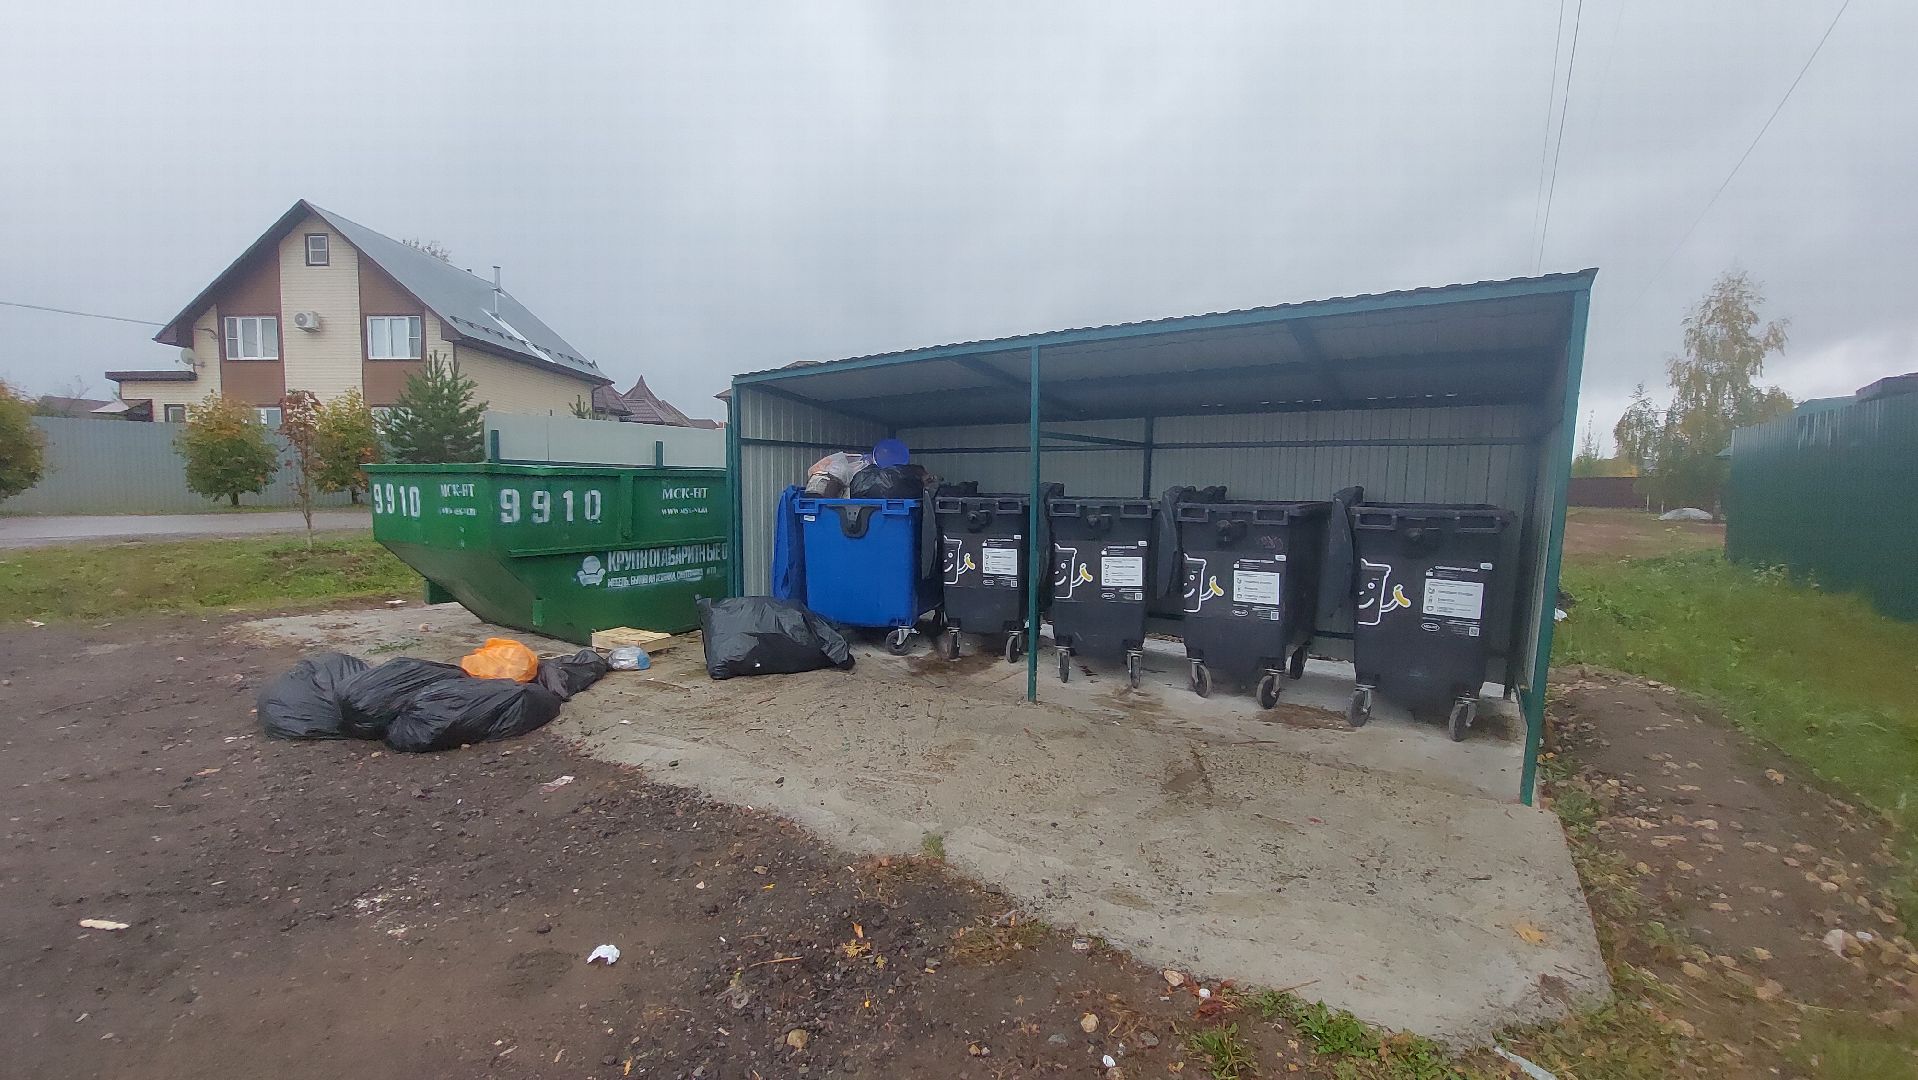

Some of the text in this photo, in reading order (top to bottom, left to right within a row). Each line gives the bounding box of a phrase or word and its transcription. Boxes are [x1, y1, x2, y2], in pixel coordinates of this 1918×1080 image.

[373, 483, 420, 517] 9910
[500, 489, 602, 524] 9910
[662, 487, 709, 499] МСК-НТ
[608, 543, 721, 572] КРУПНОГАБАРИТНЫЕ
